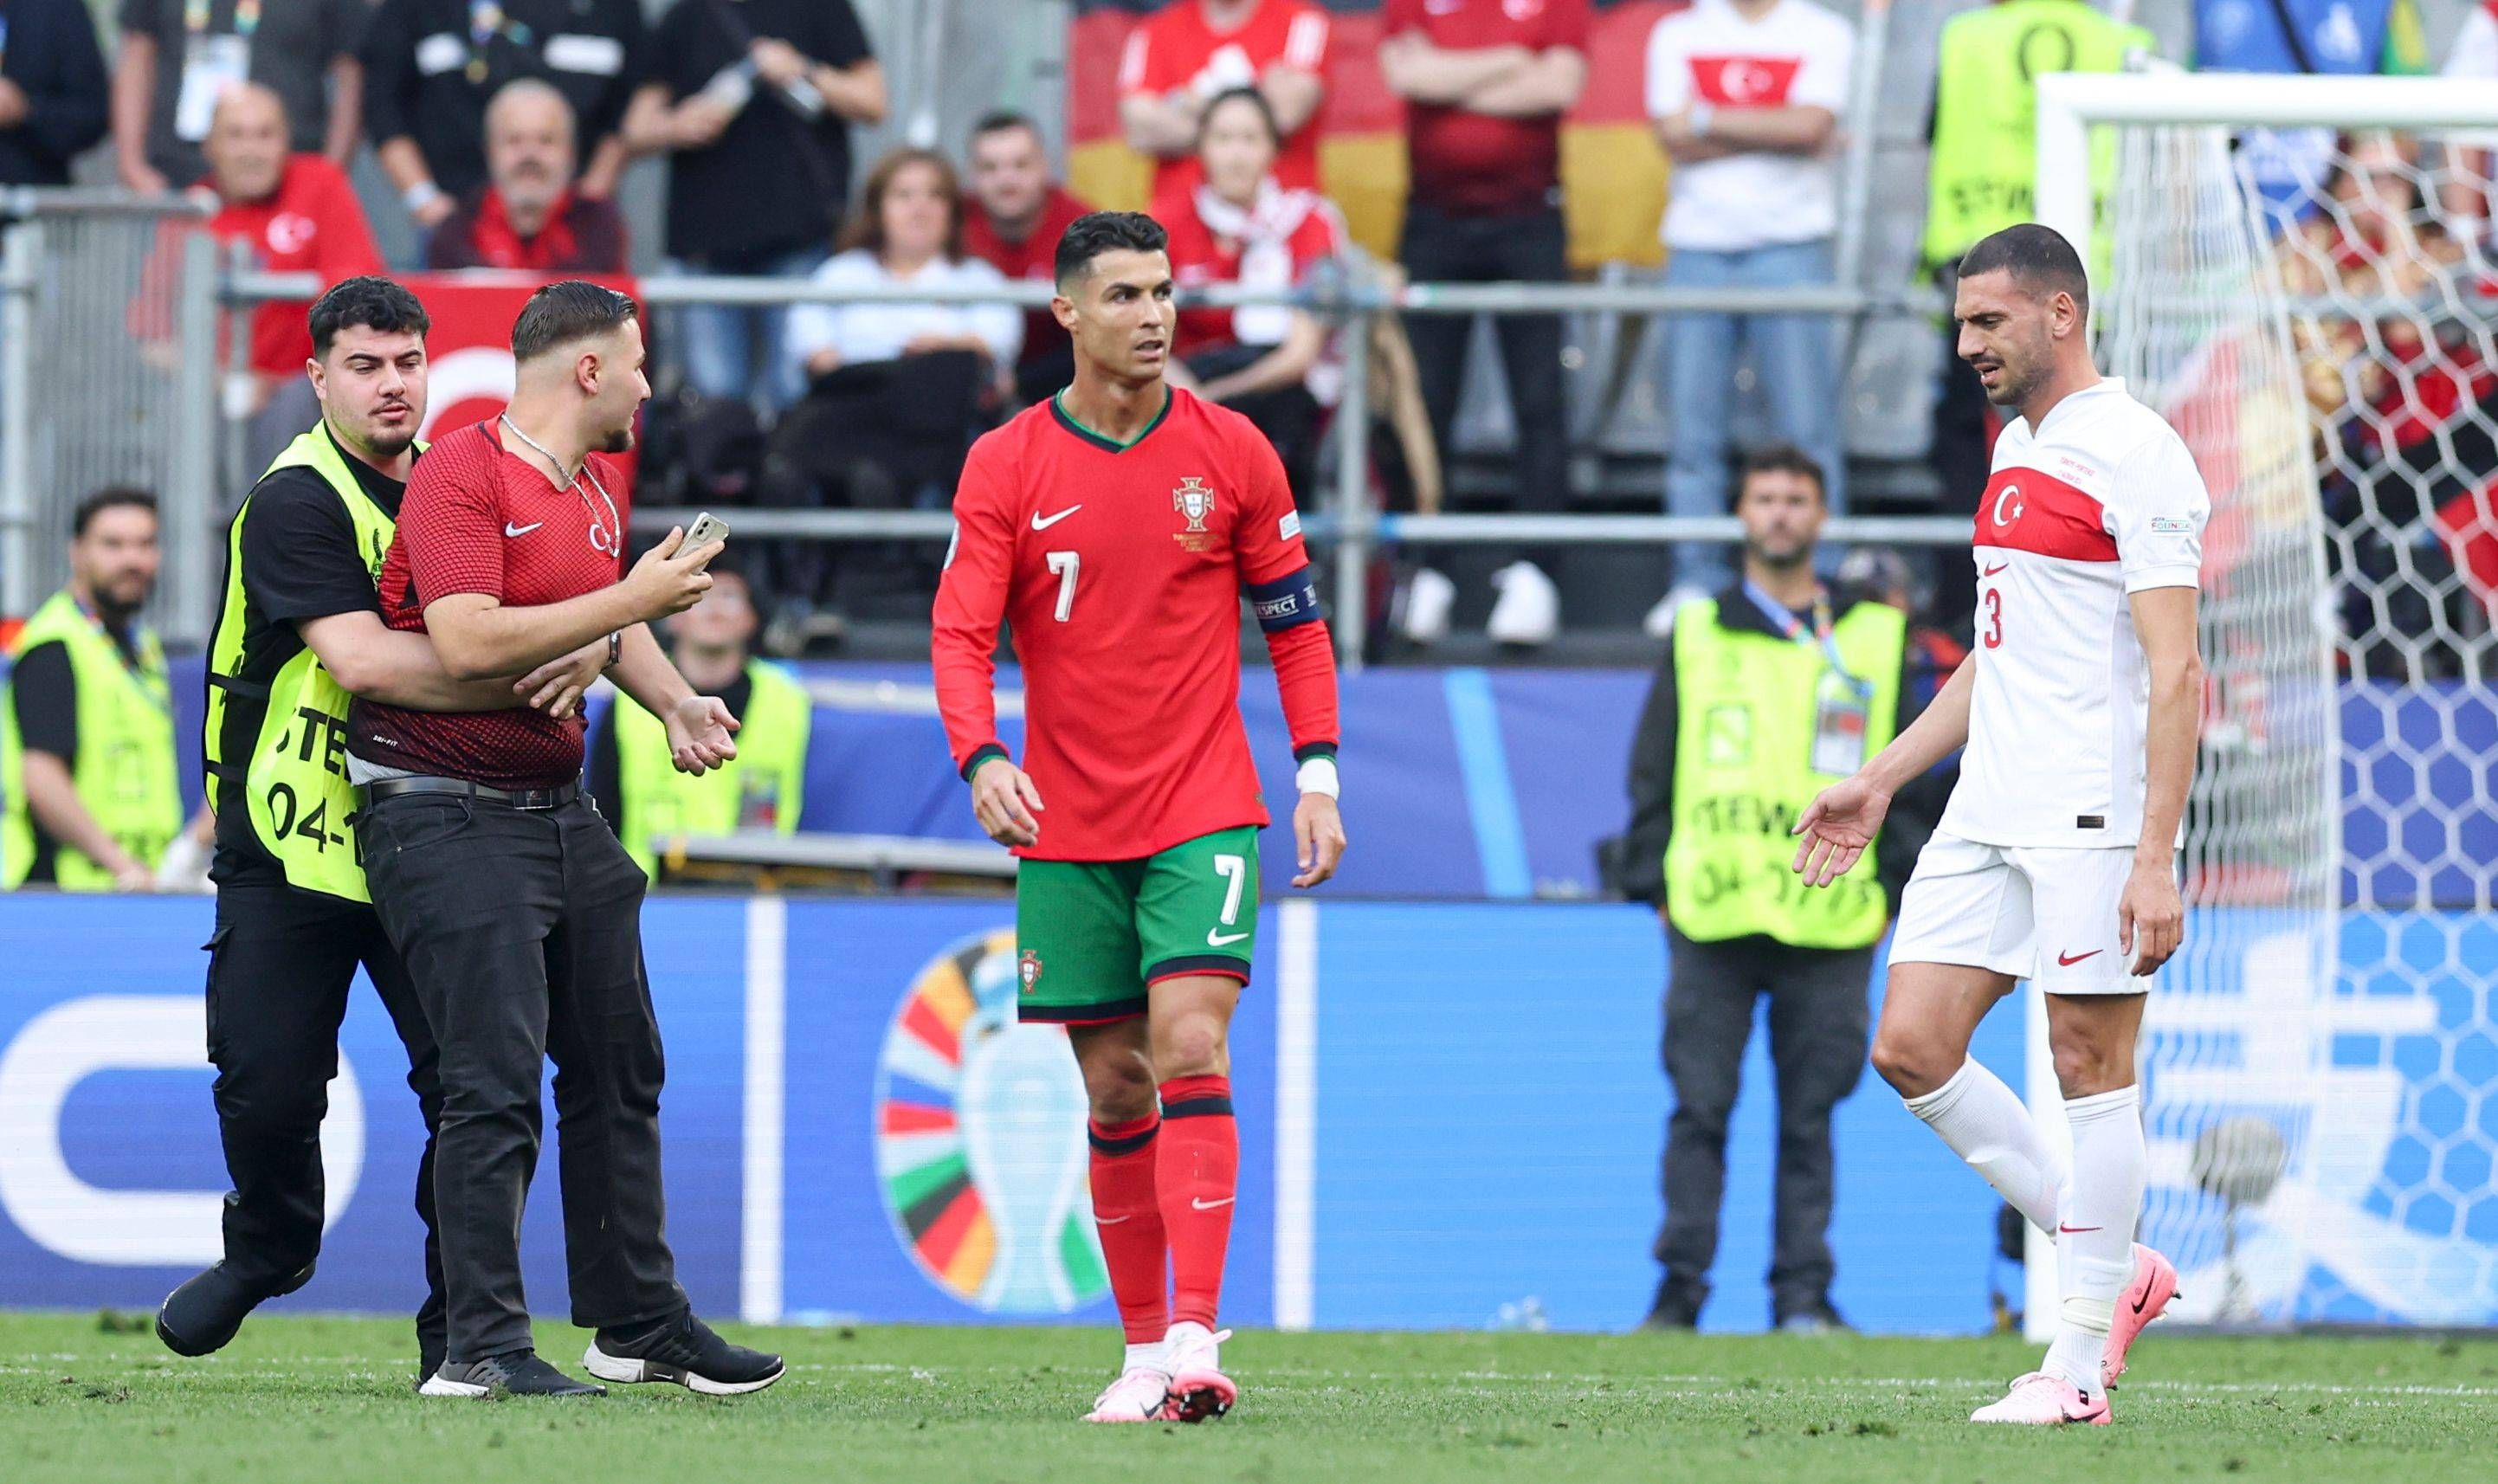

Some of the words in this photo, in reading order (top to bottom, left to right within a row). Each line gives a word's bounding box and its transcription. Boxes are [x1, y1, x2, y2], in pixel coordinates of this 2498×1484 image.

[1046, 551, 1080, 623] 7
[1984, 588, 2002, 649] 3
[1214, 854, 1245, 926] 7
